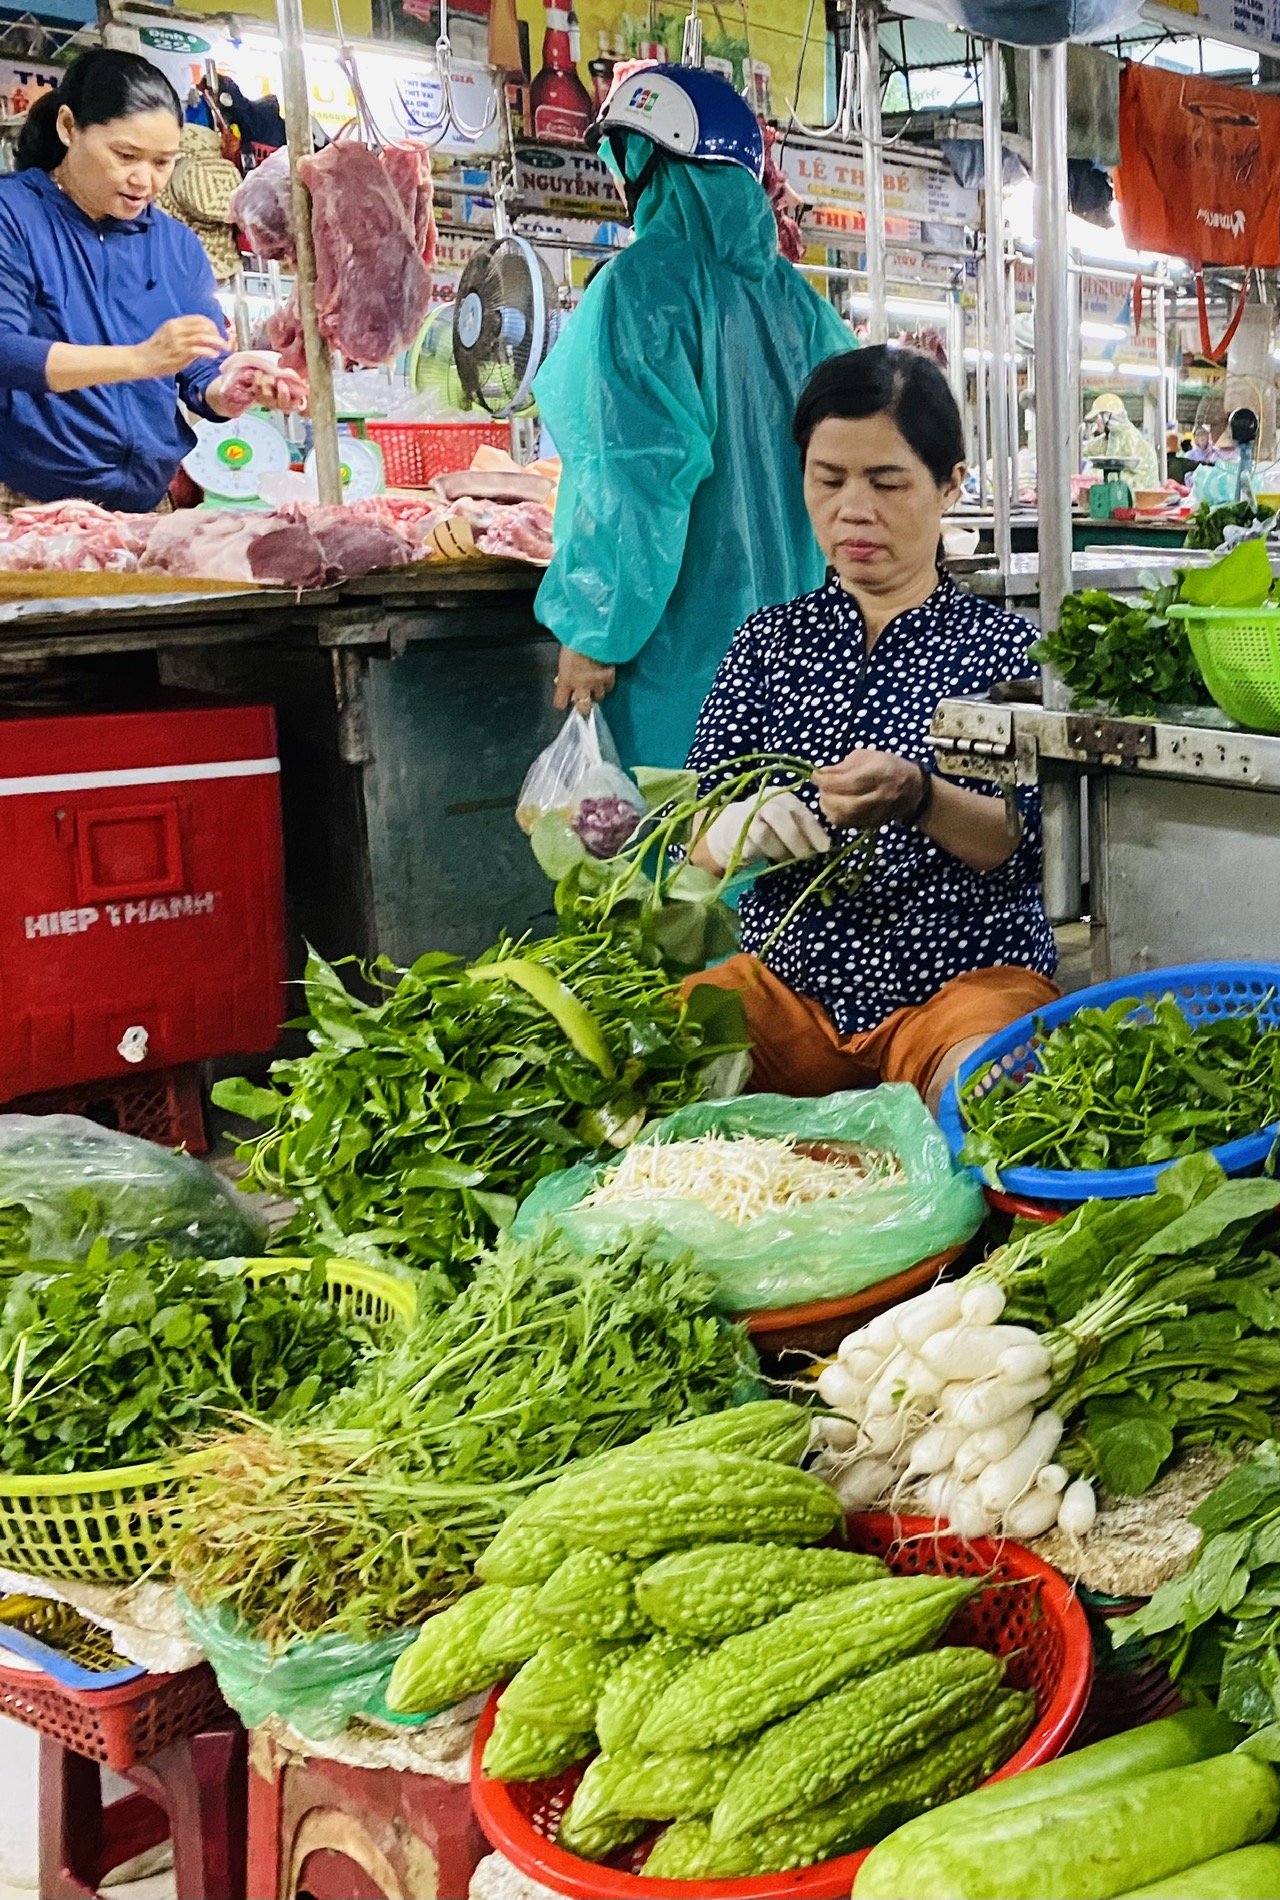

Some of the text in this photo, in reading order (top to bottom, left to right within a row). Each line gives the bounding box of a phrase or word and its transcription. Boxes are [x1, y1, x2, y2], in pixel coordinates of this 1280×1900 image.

[155, 38, 190, 52] 22
[13, 69, 58, 88] TH
[797, 157, 828, 181] LÊ
[522, 172, 599, 200] NGUYỄN
[813, 210, 847, 232] THỊ
